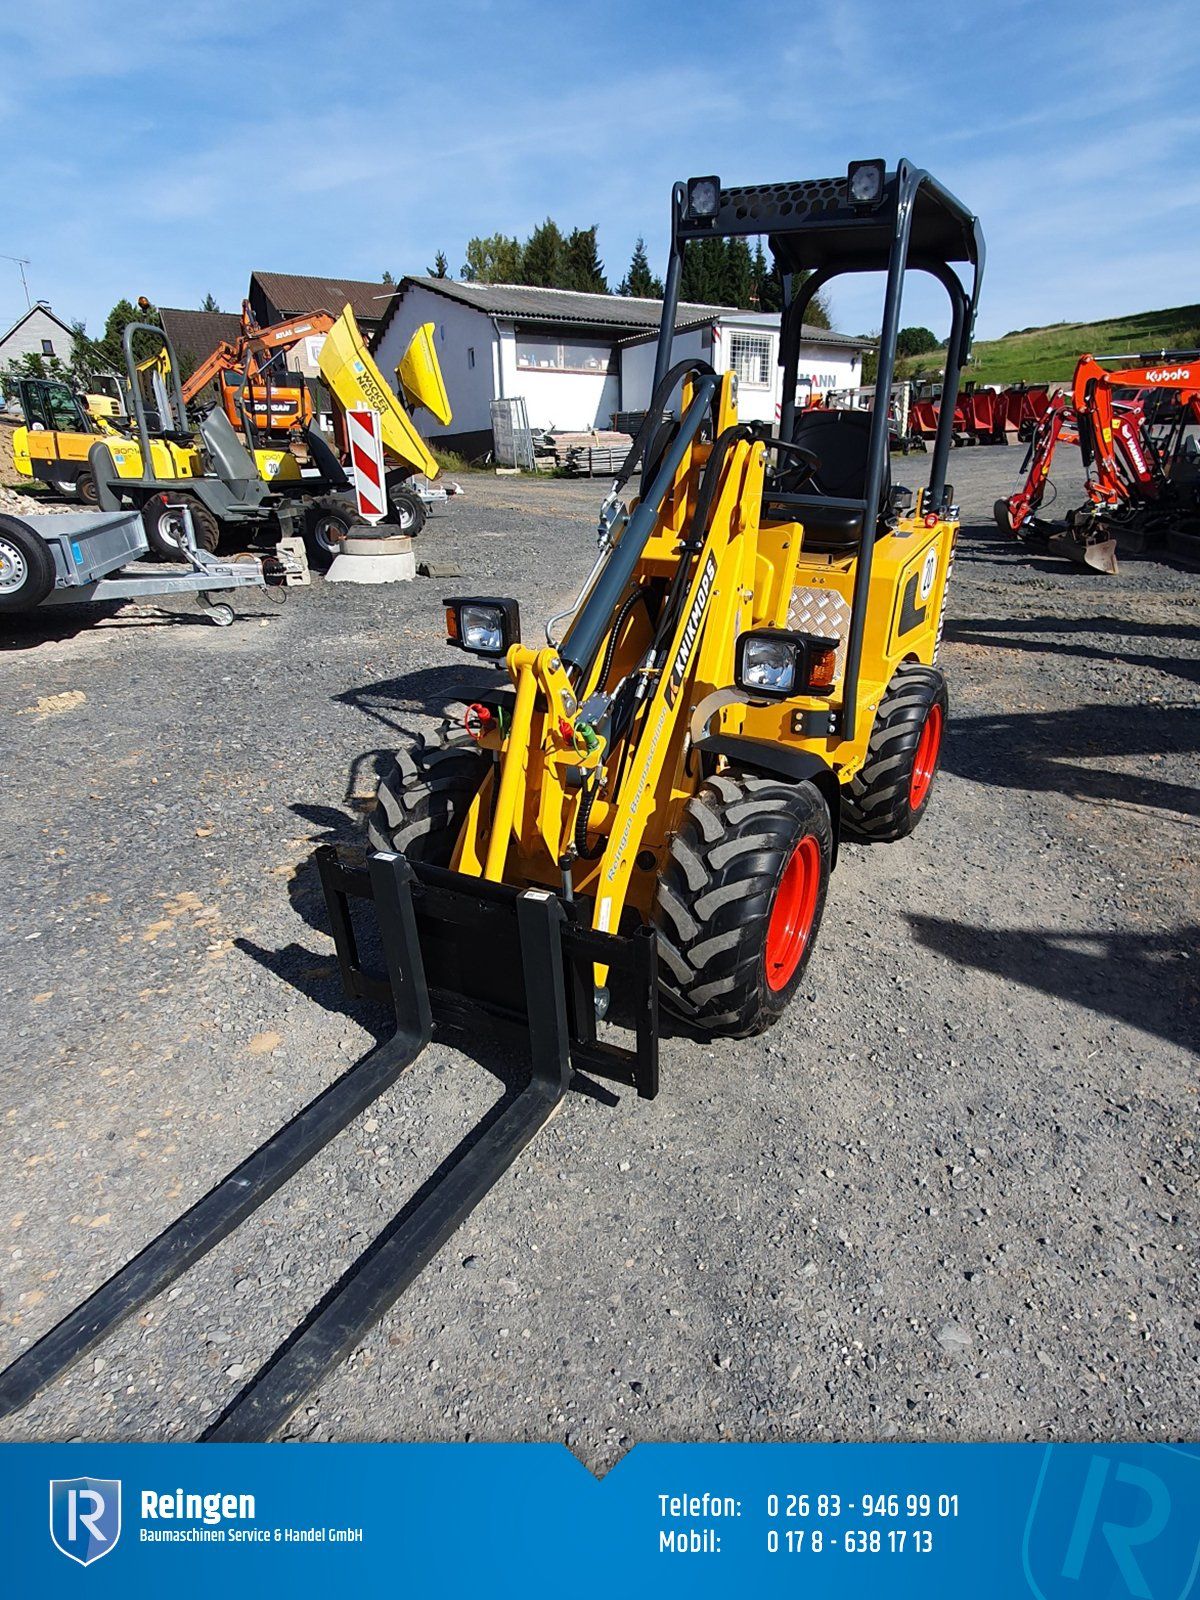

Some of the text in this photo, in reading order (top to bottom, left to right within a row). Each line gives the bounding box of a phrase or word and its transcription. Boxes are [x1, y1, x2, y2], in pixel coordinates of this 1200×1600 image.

[363, 371, 389, 411] WACKER
[1146, 368, 1190, 382] Kubota
[268, 462, 279, 474] 20
[1127, 437, 1146, 474] YANMAR
[923, 557, 934, 590] 20
[675, 559, 715, 679] KNIKMOPS
[607, 817, 633, 882] Reingen
